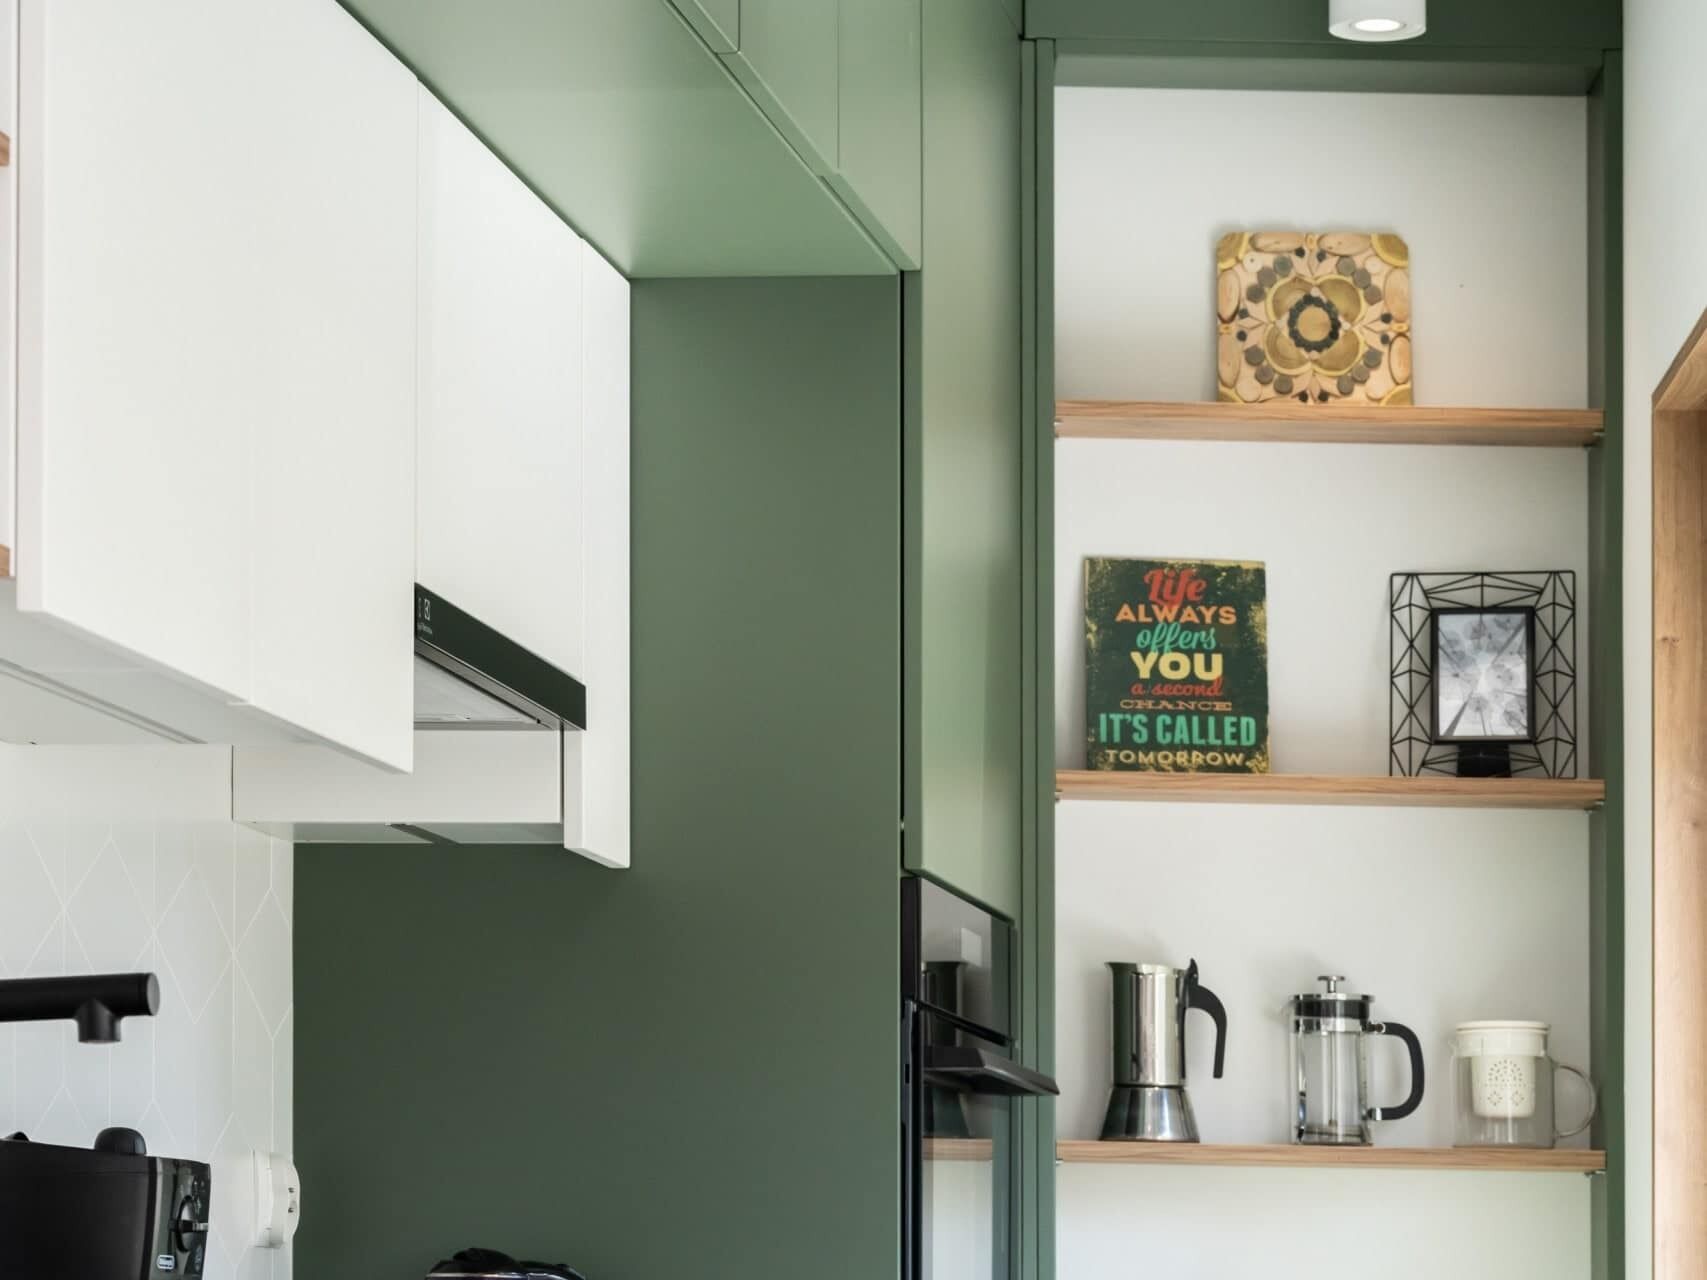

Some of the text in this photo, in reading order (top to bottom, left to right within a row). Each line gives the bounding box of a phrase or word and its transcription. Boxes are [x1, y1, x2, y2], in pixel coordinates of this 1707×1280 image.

[1144, 568, 1207, 608] Life
[1115, 604, 1237, 625] ALWAYS
[1136, 622, 1217, 653] offers
[1130, 651, 1223, 681] YOU
[1131, 677, 1225, 697] a second
[1119, 699, 1233, 711] CHANCE
[1098, 713, 1256, 746] IT'S CALLED
